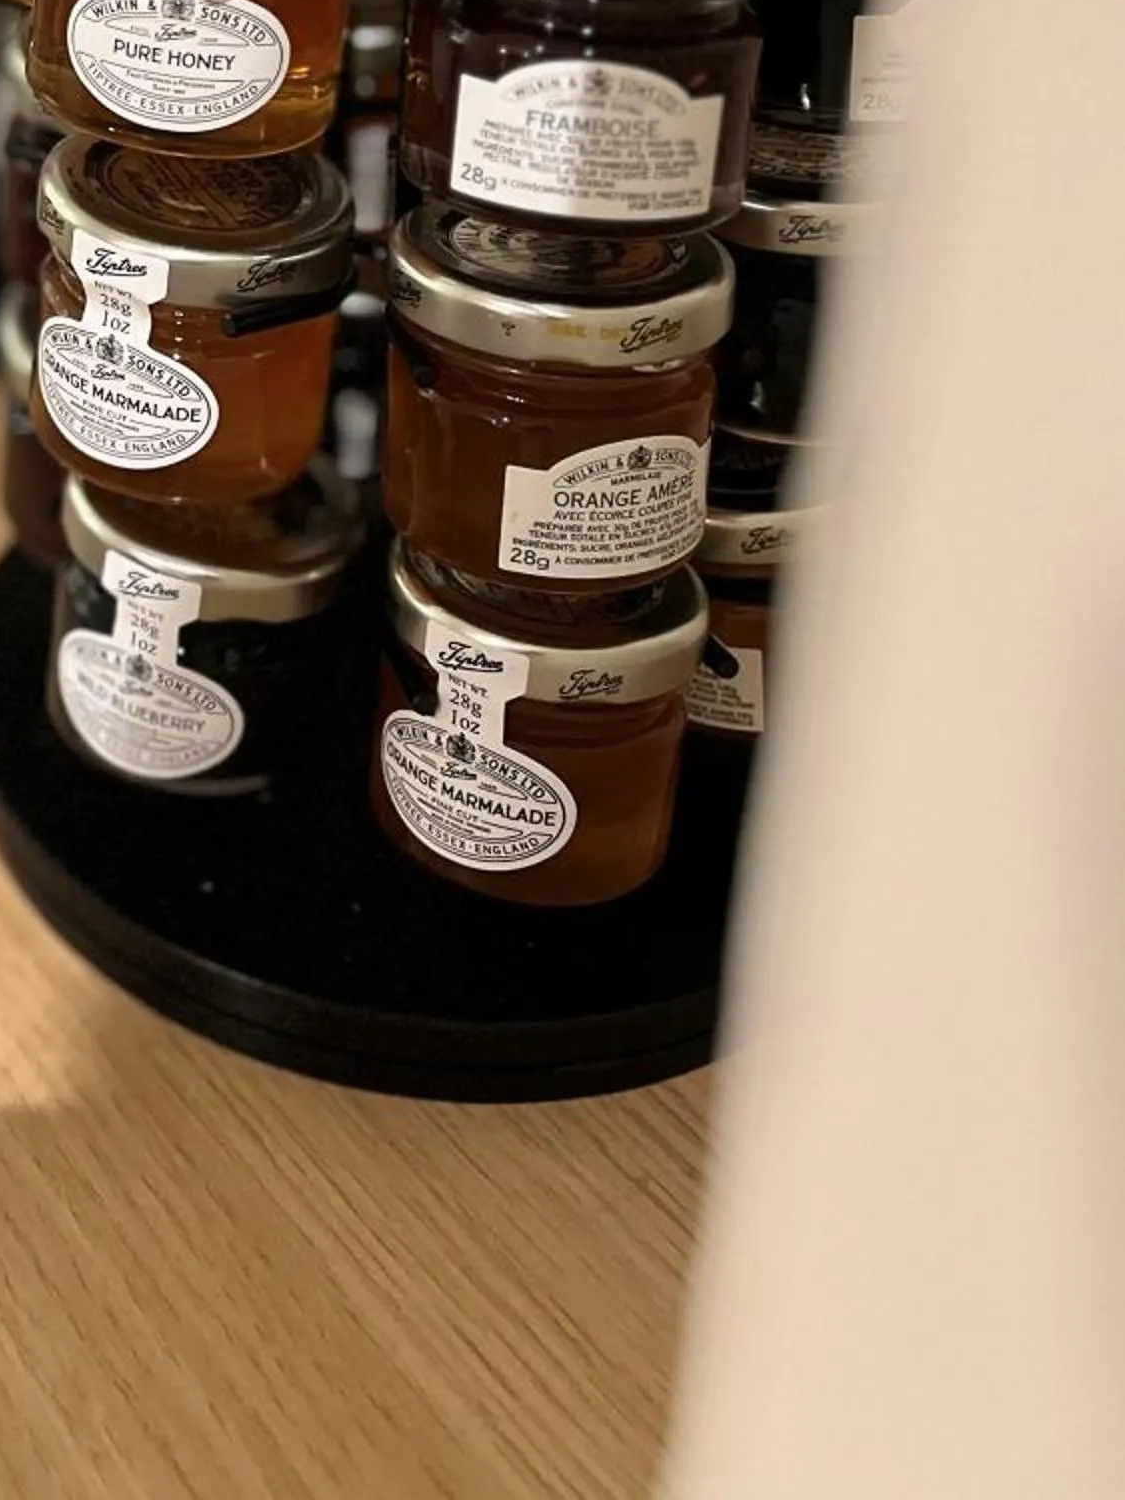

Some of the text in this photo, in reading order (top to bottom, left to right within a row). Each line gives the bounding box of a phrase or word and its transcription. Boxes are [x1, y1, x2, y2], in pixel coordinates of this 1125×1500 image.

[91, 0, 266, 43] WILKIN & SONS LTD
[114, 38, 236, 71] PURE HONEY
[140, 97, 184, 115] ESSEX
[195, 85, 258, 115] ENGLAND
[526, 109, 662, 140] FRAMBOISE
[460, 163, 497, 191] 28g
[85, 247, 148, 277] Tiptree
[100, 293, 132, 317] 28g
[126, 355, 165, 380] SONS
[166, 376, 190, 397] LTD
[92, 384, 202, 423] MARMALADE
[563, 458, 609, 485] WILKIN
[616, 456, 624, 469] &
[554, 488, 643, 509] ORANGE
[554, 510, 586, 521] AVEC
[510, 547, 550, 571] 28g
[118, 571, 180, 601] Tiptree
[437, 642, 504, 673] Tiptree
[557, 669, 624, 700] Tiptree
[450, 689, 482, 718] 28g
[386, 742, 438, 791] ORANGE
[440, 781, 557, 827] MARMALADE
[479, 753, 519, 781] SONS
[521, 777, 546, 799] LTD
[475, 836, 540, 856] ENGLAND
